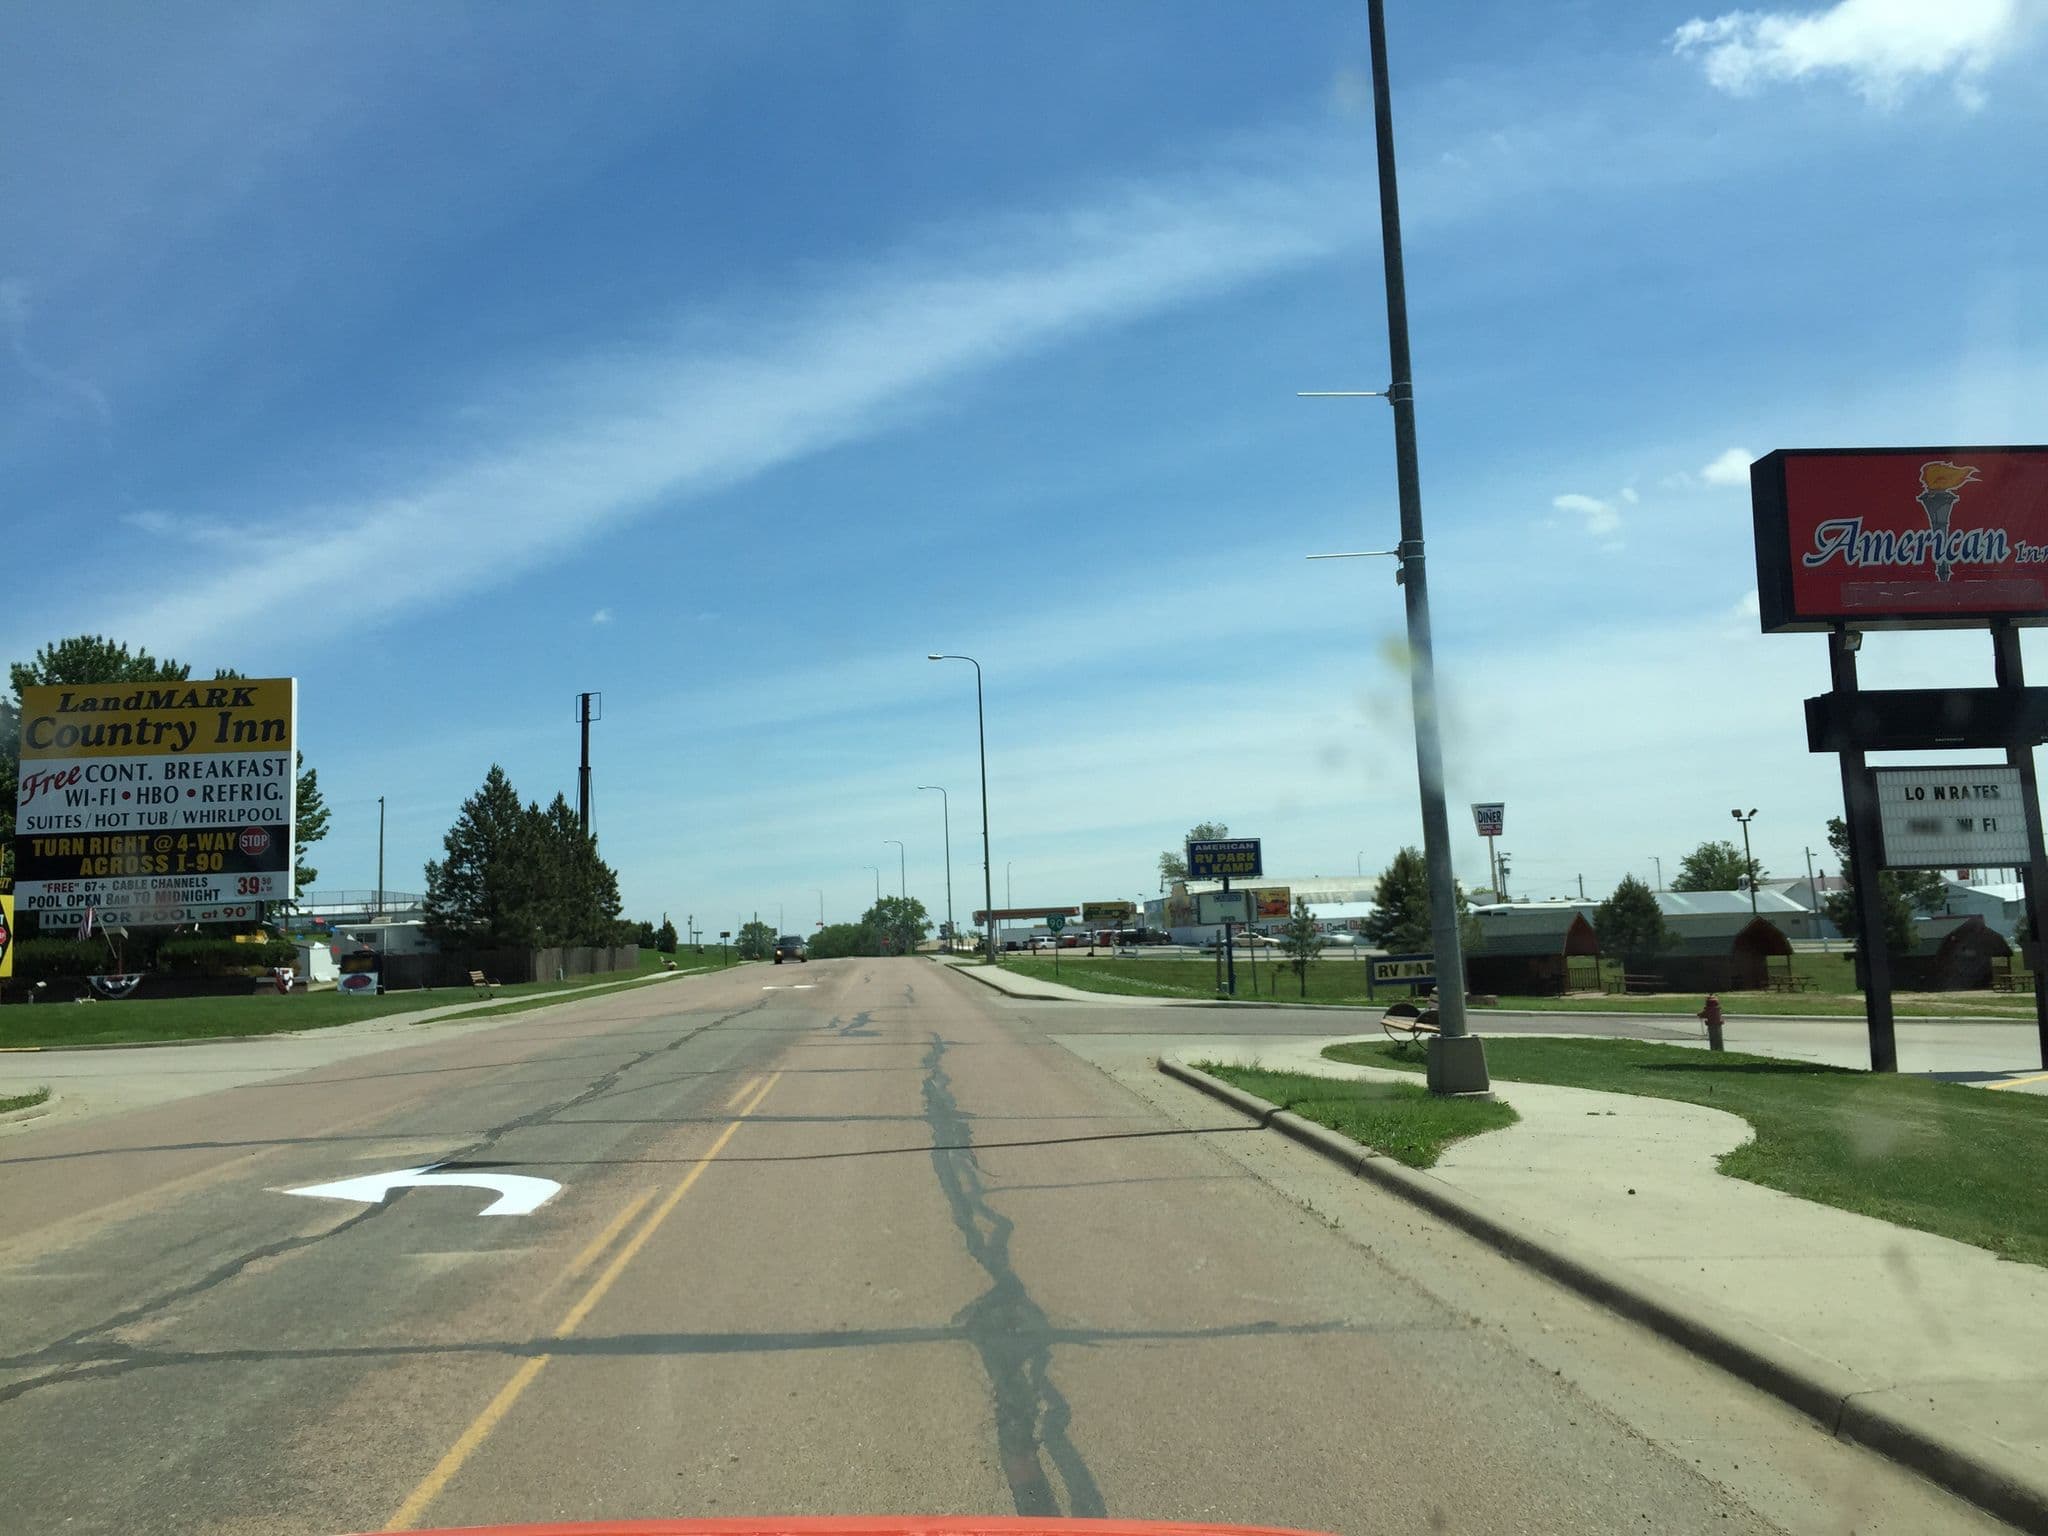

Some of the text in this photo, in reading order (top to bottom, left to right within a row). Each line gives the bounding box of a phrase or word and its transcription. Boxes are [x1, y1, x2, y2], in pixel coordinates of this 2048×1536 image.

[1803, 517, 2011, 568] American
[57, 687, 257, 713] LandMARK
[26, 712, 286, 752] Country Inn
[20, 758, 287, 807] Free CONT. BREAKFAST
[65, 782, 283, 807] WI-FI HBO REFRIG.
[1478, 810, 1502, 823] DINER
[32, 832, 268, 857] TURN RIGHT @ 4-WAY STOP
[1195, 843, 1254, 851] AMERICAN
[80, 853, 223, 876] ACROSS I-90
[1219, 852, 1256, 863] PARK
[1211, 862, 1254, 873] KAMP
[113, 880, 146, 891] CABLE
[151, 877, 208, 889] CHANNELS
[237, 876, 260, 895] 39
[28, 895, 62, 908] POOL
[67, 893, 101, 907] OPEN
[156, 889, 220, 904] MIDNIGHT
[45, 912, 132, 925] INDOR
[1050, 918, 1063, 929] 90
[1378, 964, 1399, 977] RV
